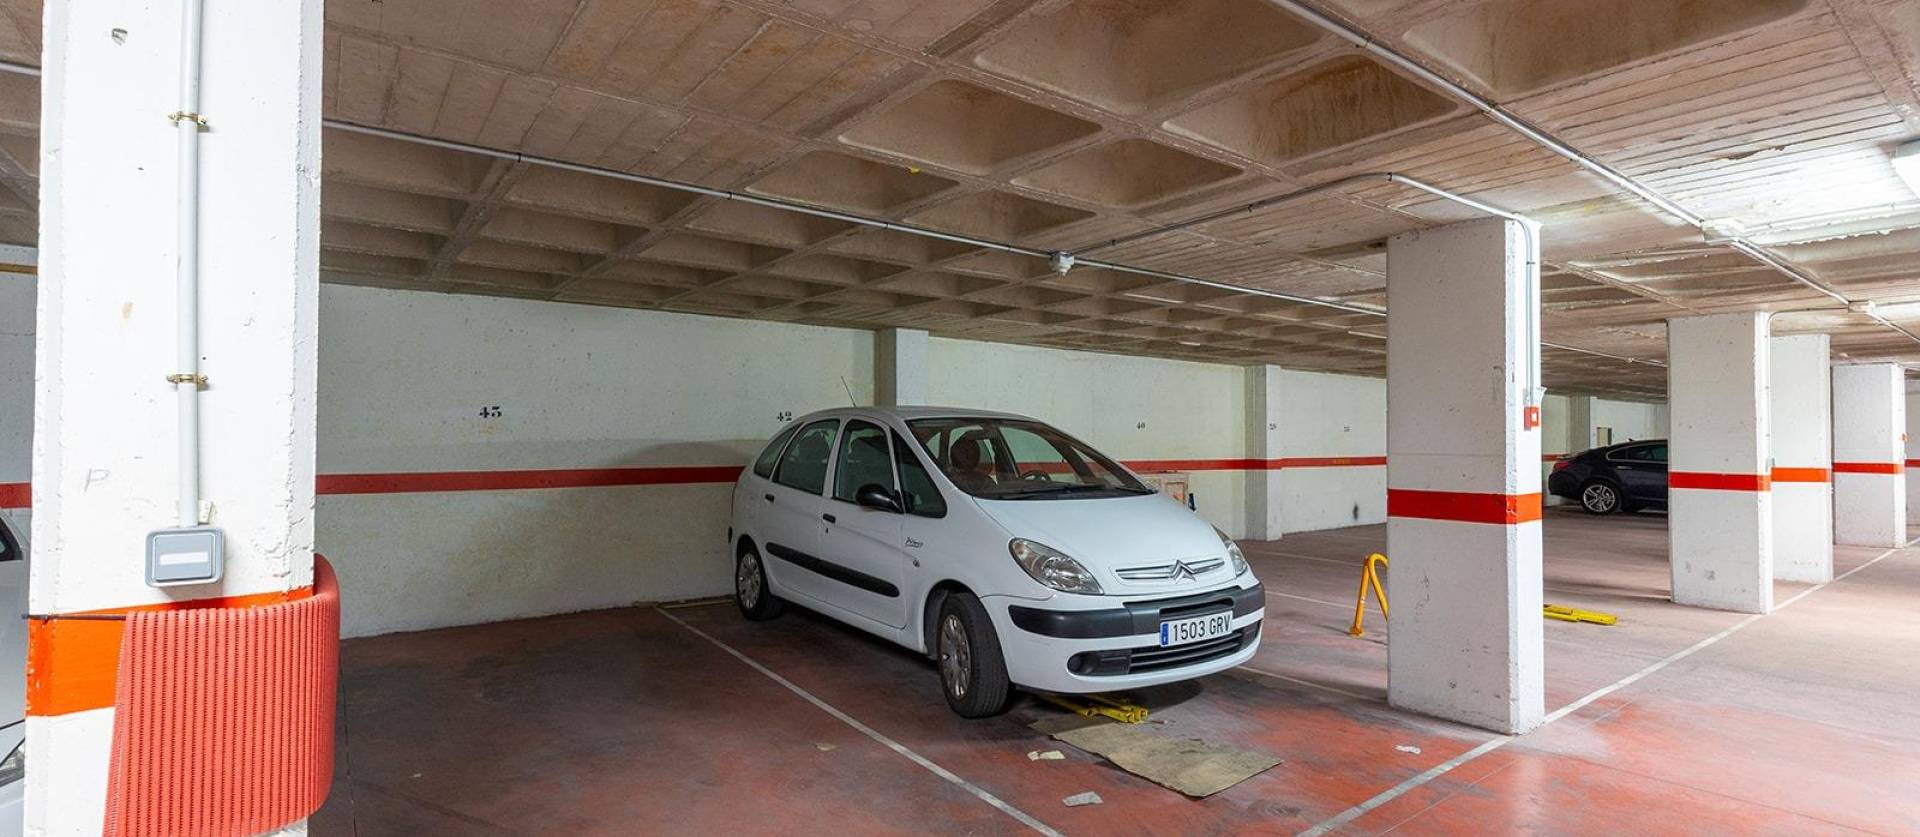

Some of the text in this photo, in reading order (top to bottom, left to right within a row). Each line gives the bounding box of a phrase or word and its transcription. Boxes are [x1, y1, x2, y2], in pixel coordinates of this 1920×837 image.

[776, 411, 793, 422] 42
[1173, 614, 1231, 642] 1503 GRV
